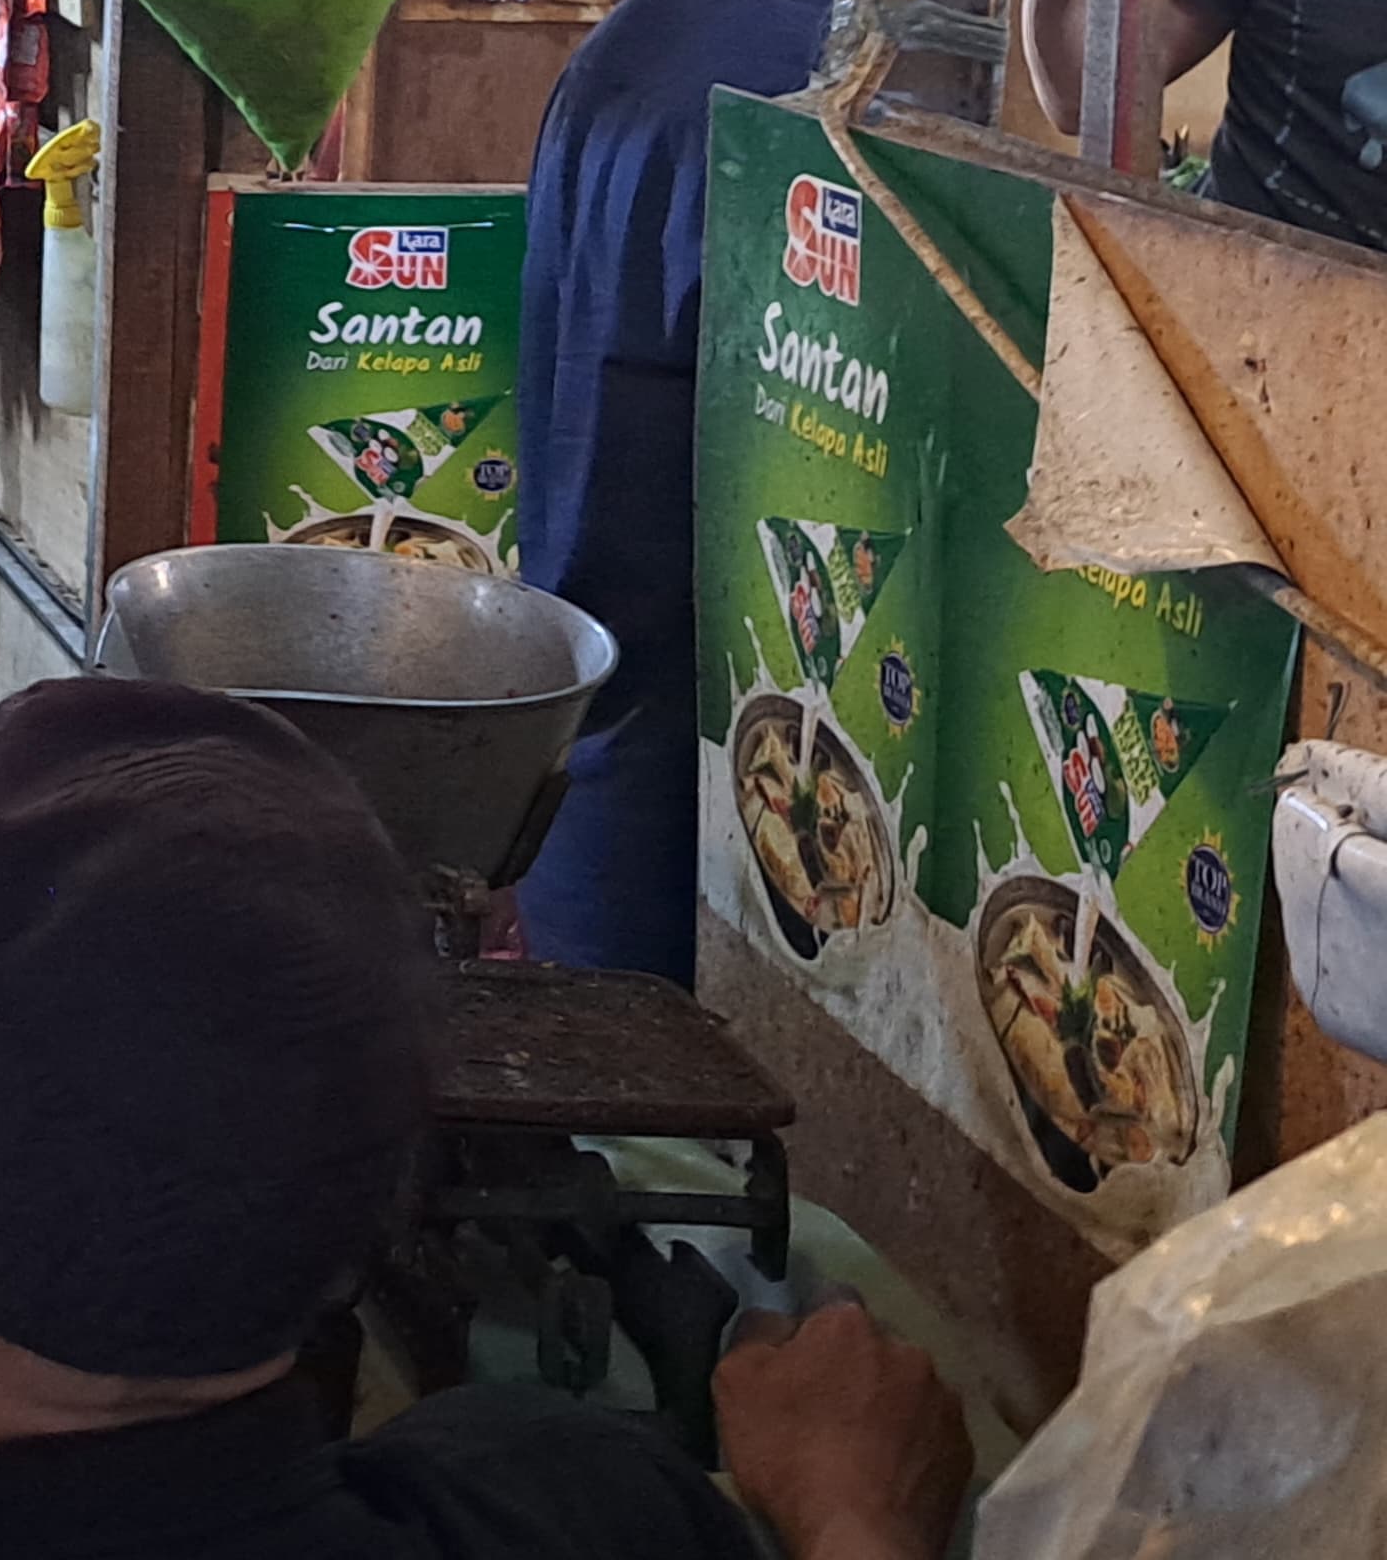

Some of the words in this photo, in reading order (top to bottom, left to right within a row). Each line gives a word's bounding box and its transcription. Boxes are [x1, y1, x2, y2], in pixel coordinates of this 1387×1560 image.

[349, 230, 446, 287] SUN
[401, 231, 442, 251] kara
[784, 179, 859, 304] SUN
[308, 301, 483, 346] Santan
[306, 351, 348, 372] Dari
[357, 351, 430, 375] Kelapa
[440, 351, 483, 372] Asli
[758, 301, 890, 425] Santan
[755, 382, 787, 427] Dari
[790, 400, 847, 458] Kelapa
[852, 431, 889, 479] Asli
[1076, 564, 1148, 610] elapa
[1155, 582, 1204, 639] Asli
[1063, 748, 1100, 839] SUN
[1191, 857, 1229, 899] TOP
